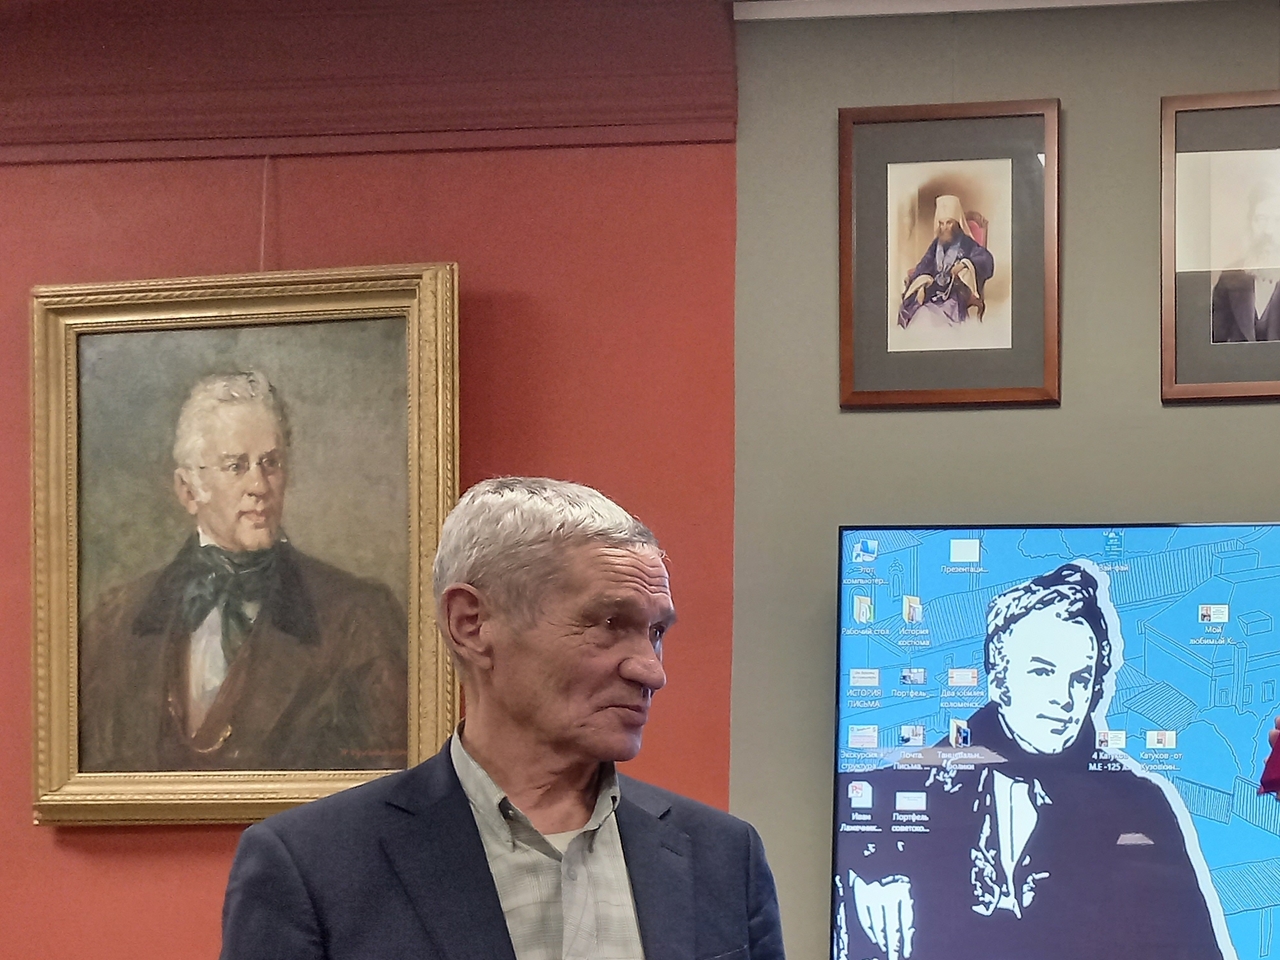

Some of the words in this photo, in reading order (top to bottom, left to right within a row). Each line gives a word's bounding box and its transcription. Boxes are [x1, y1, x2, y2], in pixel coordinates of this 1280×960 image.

[1205, 625, 1222, 633] Мой
[846, 689, 883, 697] ИСТОРИЯ
[940, 689, 956, 697] Два
[847, 700, 882, 708] ПИСЬМА
